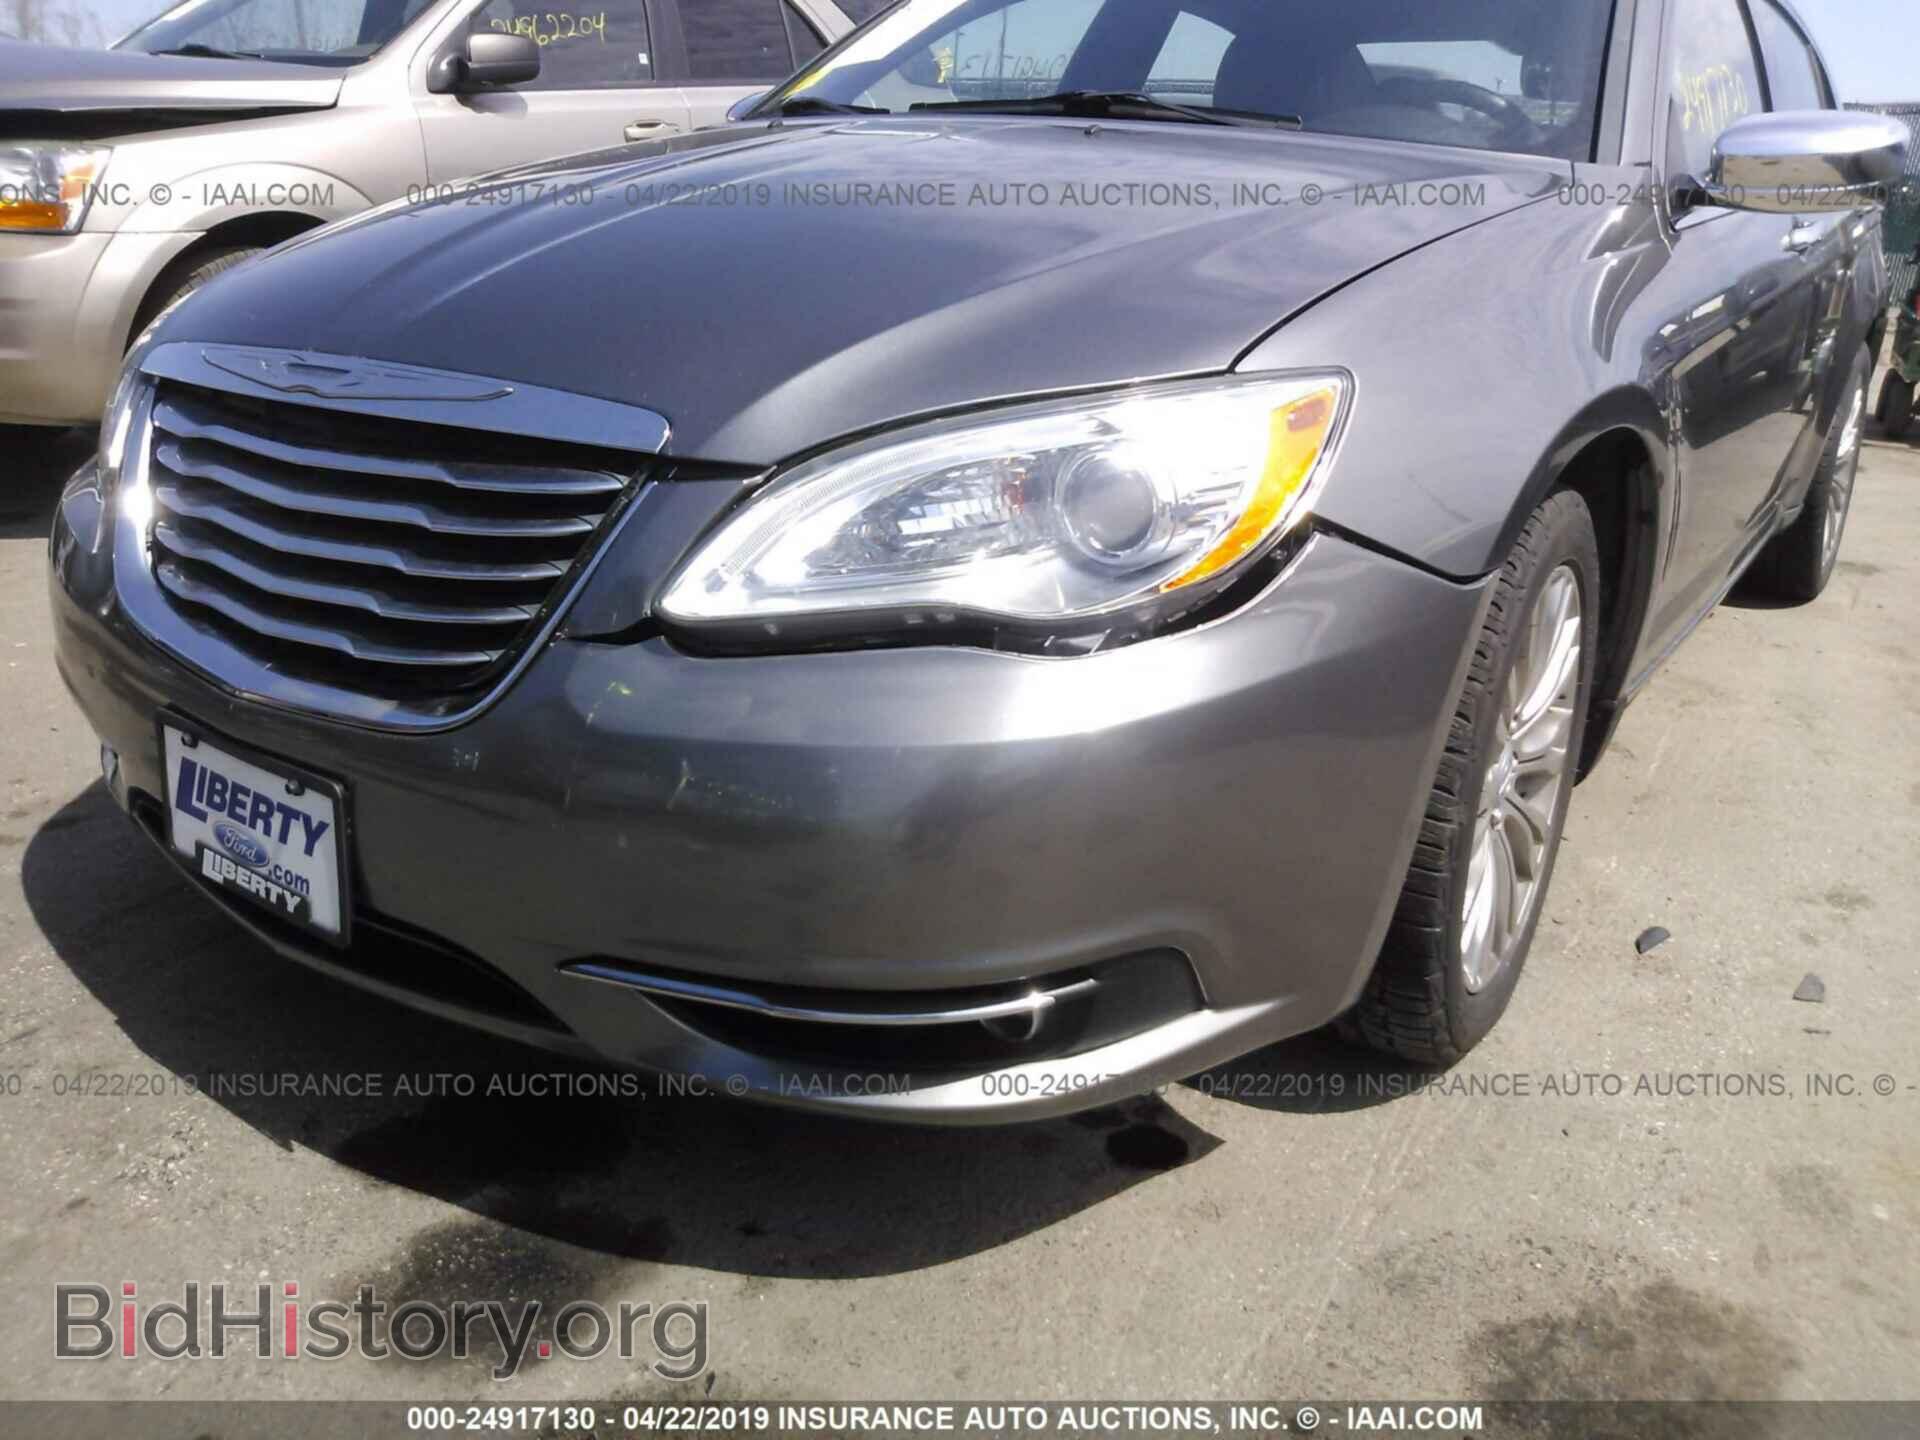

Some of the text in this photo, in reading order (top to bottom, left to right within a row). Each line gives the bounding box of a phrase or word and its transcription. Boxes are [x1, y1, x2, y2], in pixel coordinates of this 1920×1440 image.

[176, 756, 330, 857] LIBERTY
[202, 847, 302, 913] LIBERTY
[223, 828, 310, 896] Ford .com
